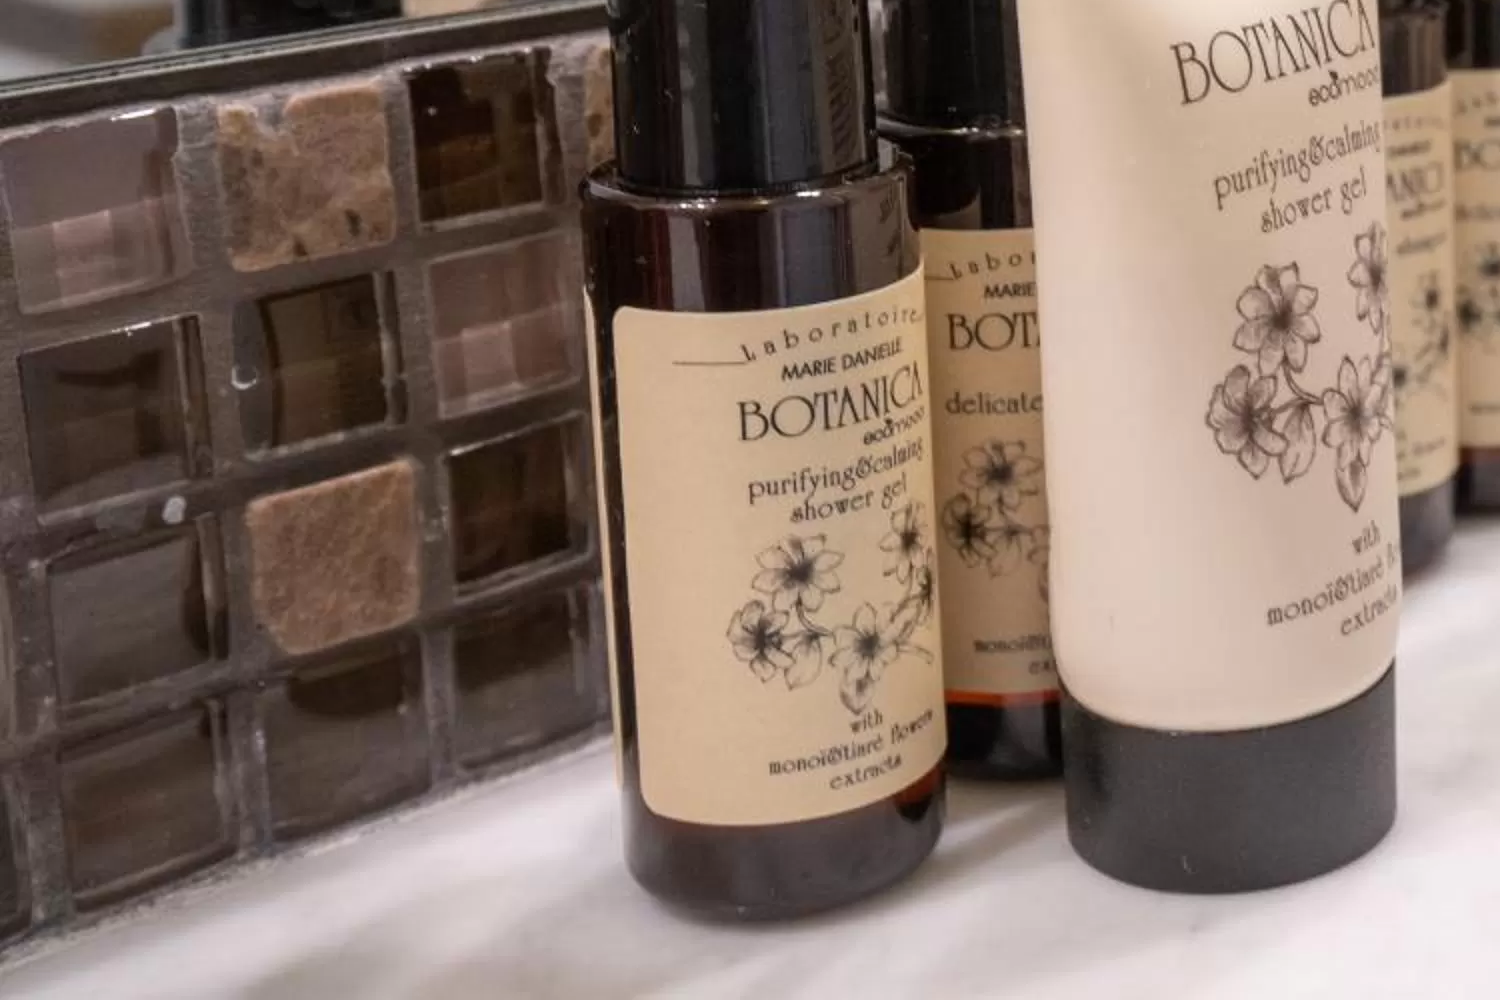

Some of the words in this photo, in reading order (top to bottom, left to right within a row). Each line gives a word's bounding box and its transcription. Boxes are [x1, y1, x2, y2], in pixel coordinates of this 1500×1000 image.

[1260, 187, 1333, 233] shower
[1339, 164, 1368, 216] gel
[780, 356, 837, 383] MARIE
[841, 335, 905, 372] DANIELLE
[737, 360, 924, 442] BOTANICA
[789, 489, 875, 524] shower
[880, 471, 908, 511] gel
[849, 707, 884, 735] with
[829, 753, 903, 790] extracts
